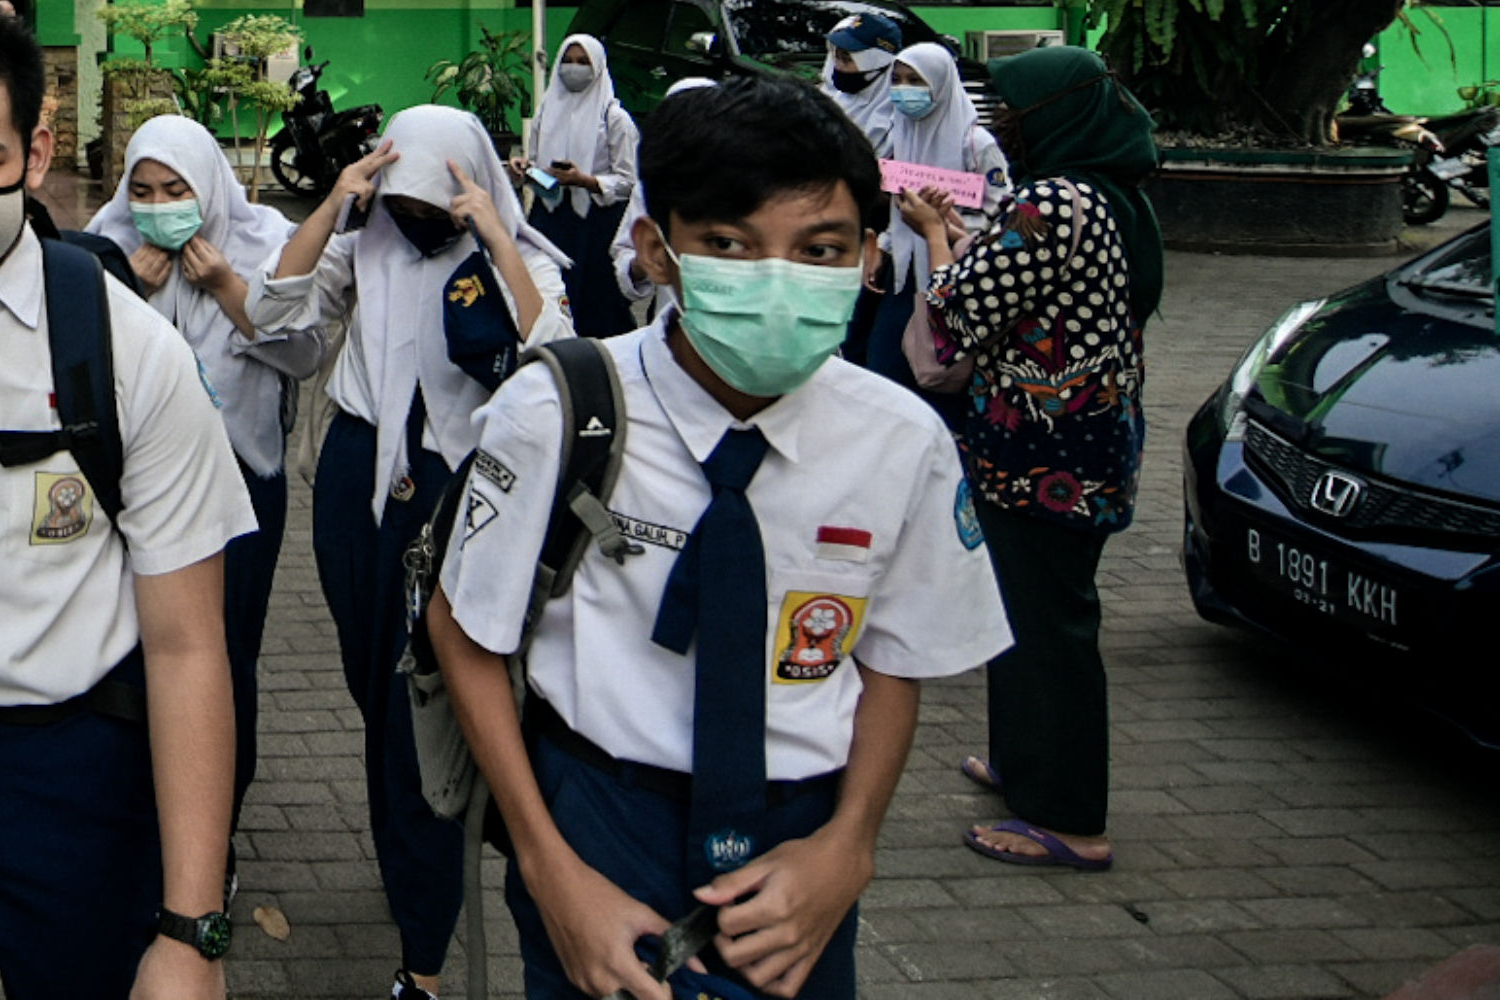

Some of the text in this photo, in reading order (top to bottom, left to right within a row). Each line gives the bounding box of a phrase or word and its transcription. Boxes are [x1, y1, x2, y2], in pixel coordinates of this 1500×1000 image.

[1248, 528, 1397, 626] B 1891 KKH
[791, 665, 829, 677] OSIS
